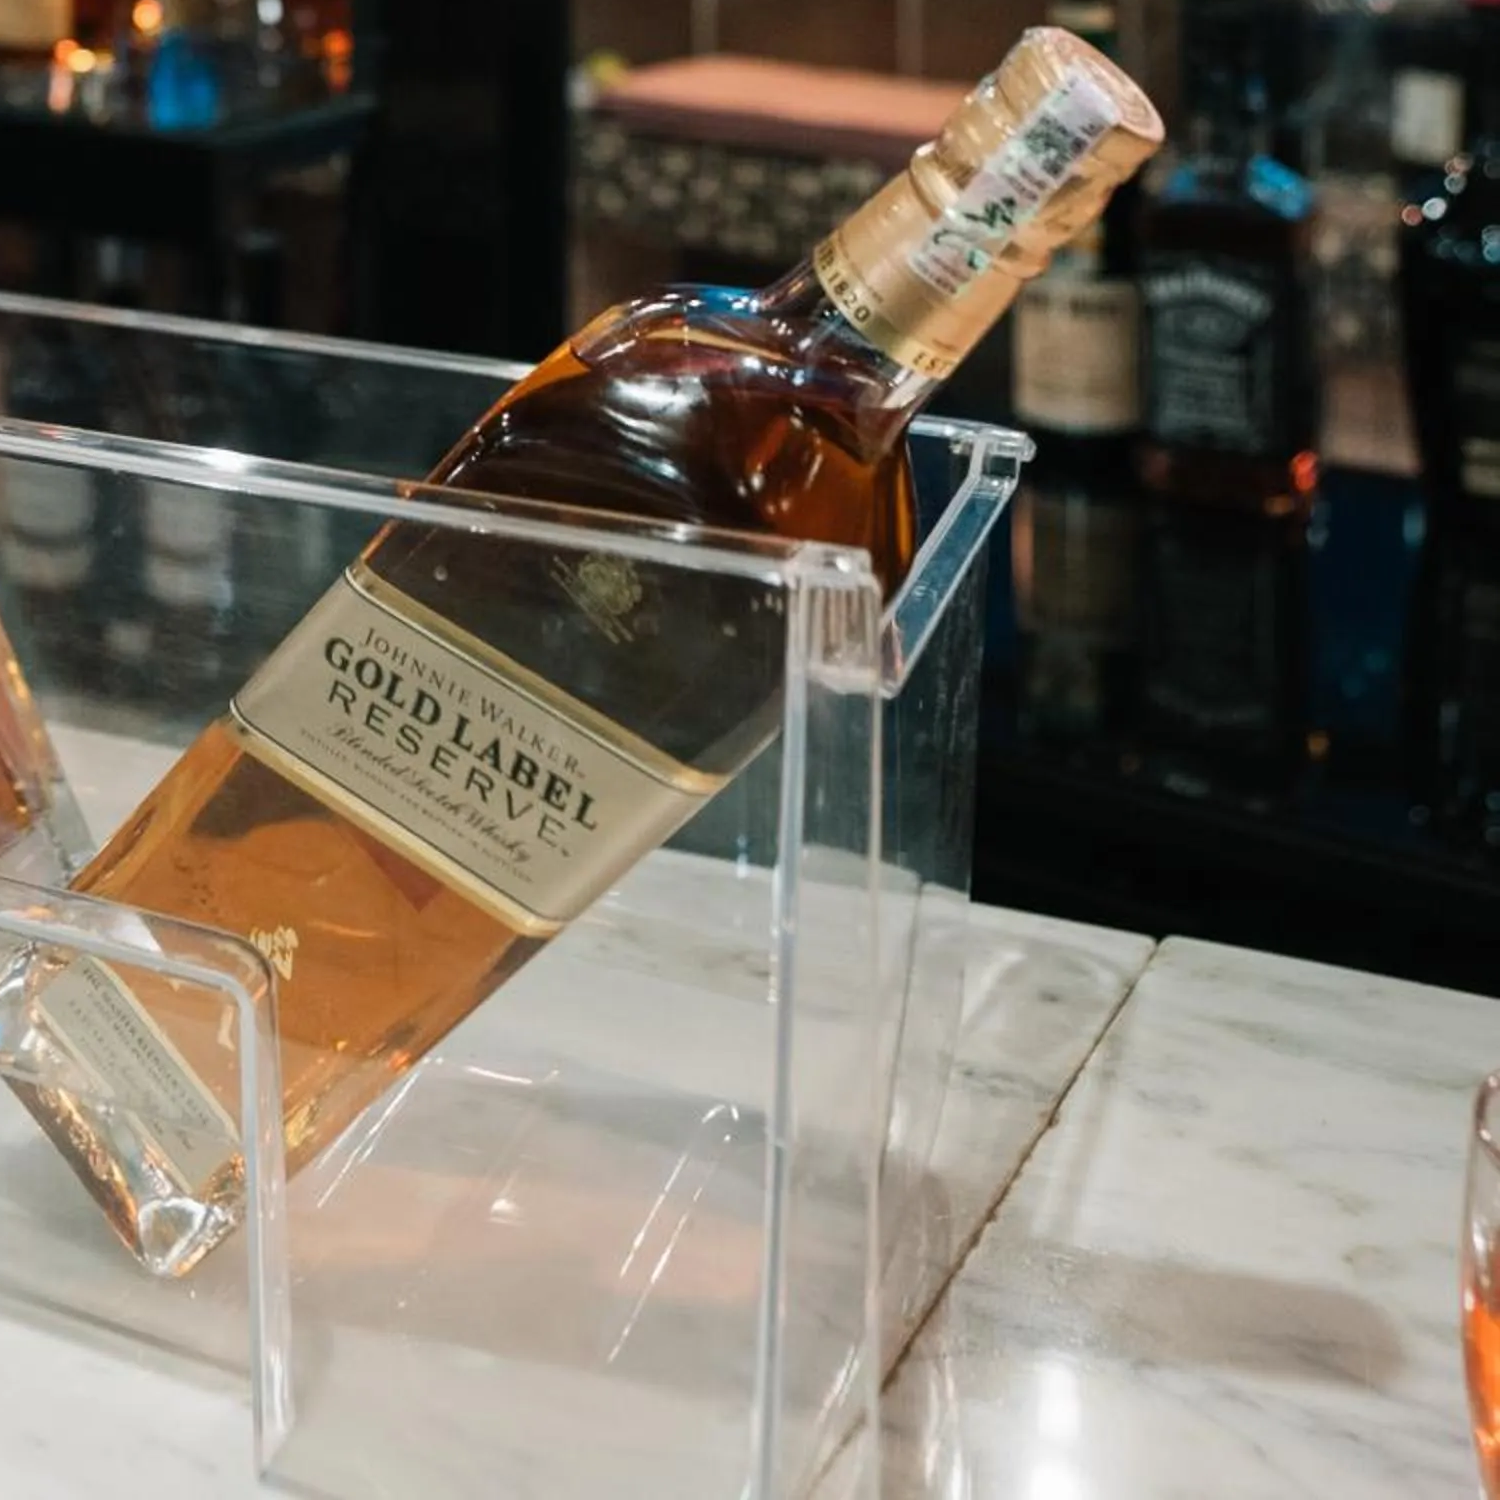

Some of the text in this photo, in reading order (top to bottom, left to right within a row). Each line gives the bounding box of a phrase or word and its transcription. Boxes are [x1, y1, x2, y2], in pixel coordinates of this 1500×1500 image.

[827, 271, 871, 324] 1820
[324, 637, 442, 726] GOLD
[449, 713, 598, 830] LABEL
[327, 678, 567, 847] RESERVE
[360, 627, 580, 774] JOHNNIE WALKER
[326, 723, 532, 865] Blended Scotch Whisky
